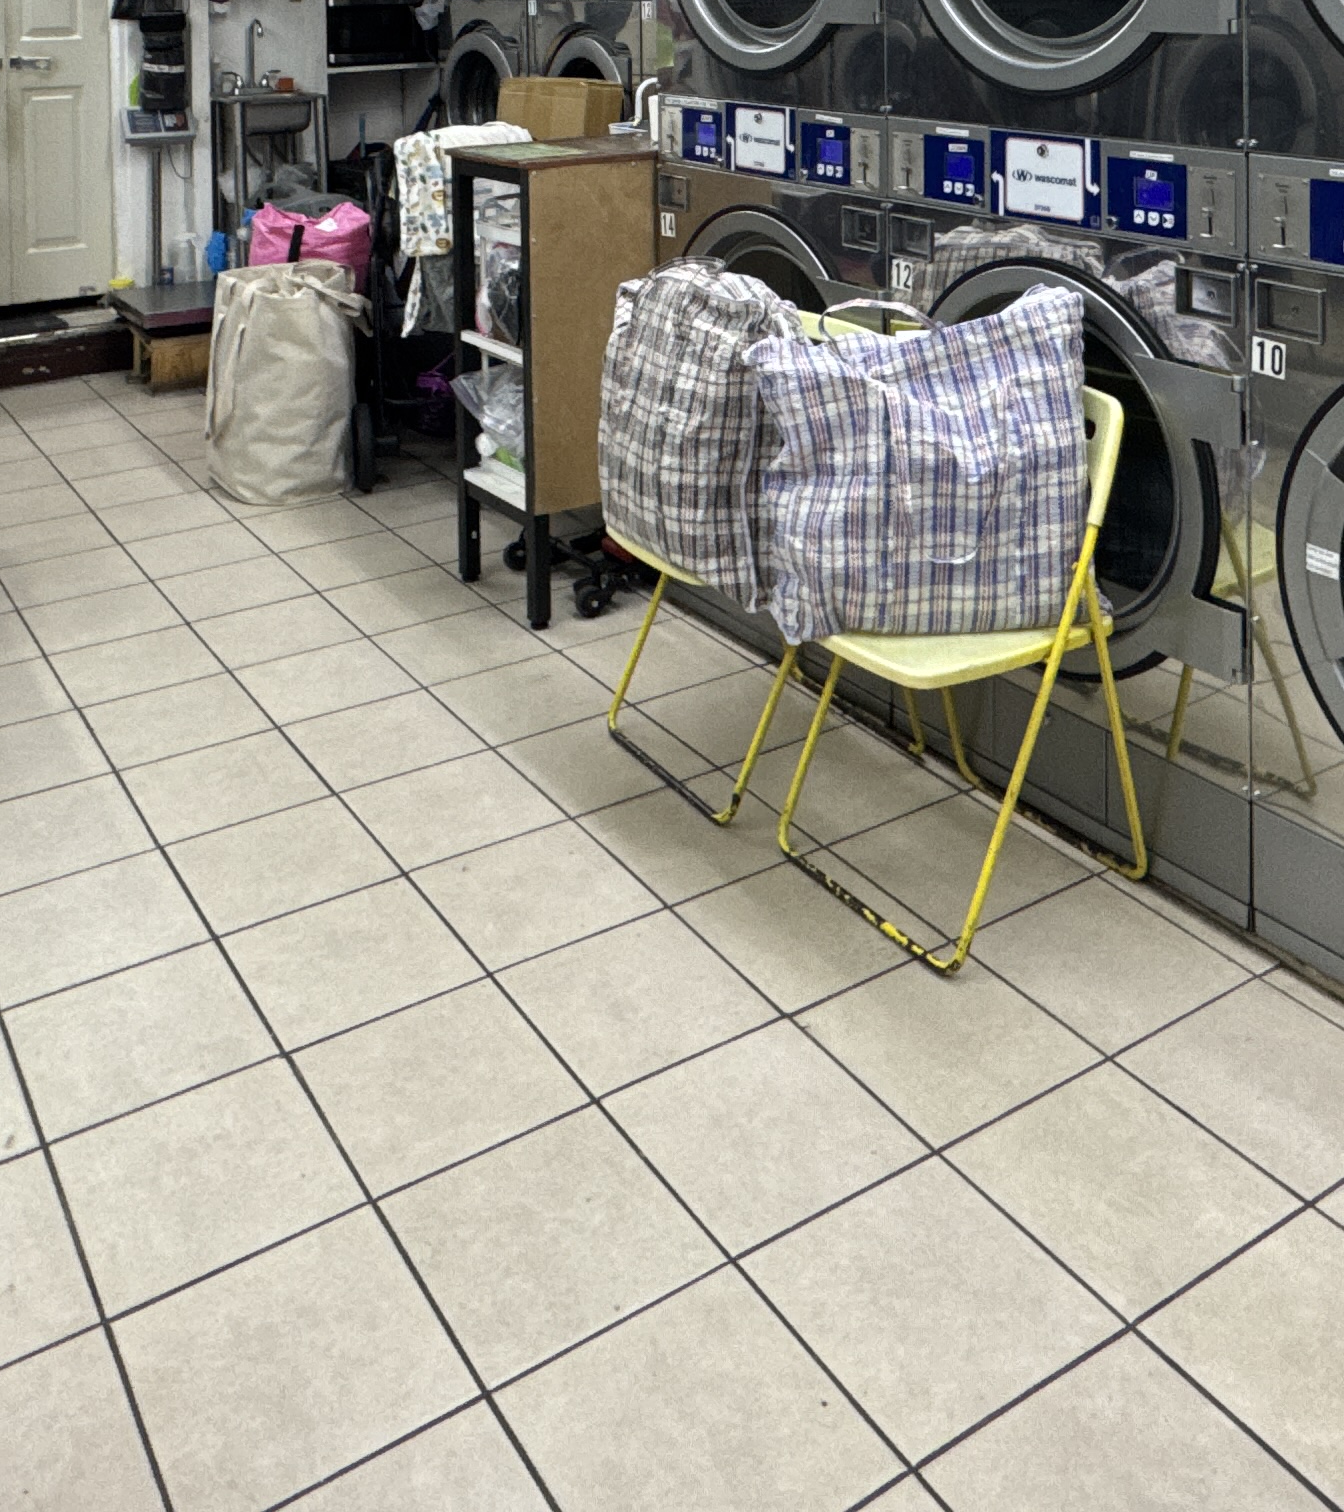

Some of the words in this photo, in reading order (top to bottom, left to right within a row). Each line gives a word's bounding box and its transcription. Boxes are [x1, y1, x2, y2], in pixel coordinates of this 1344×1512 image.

[1034, 173, 1077, 188] wascomat
[662, 213, 675, 237] 14
[893, 261, 913, 290] 12
[1254, 337, 1285, 378] 10
